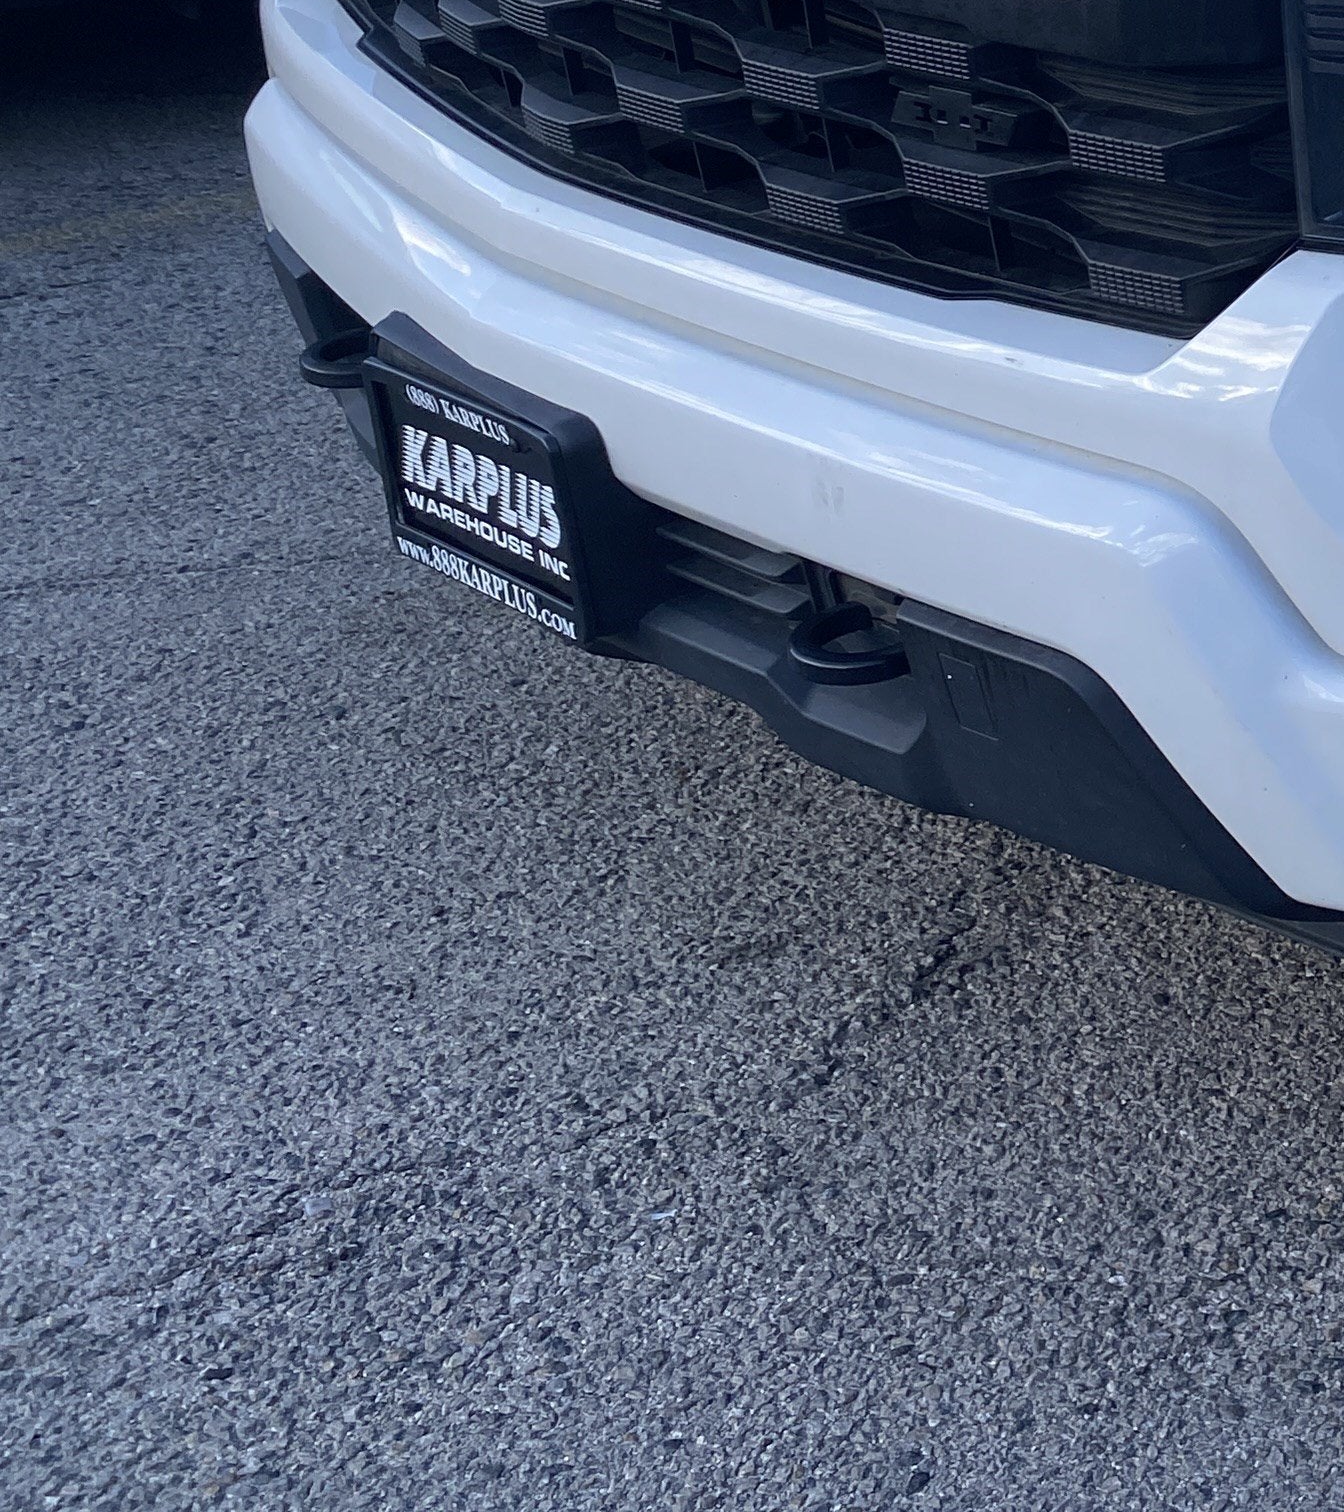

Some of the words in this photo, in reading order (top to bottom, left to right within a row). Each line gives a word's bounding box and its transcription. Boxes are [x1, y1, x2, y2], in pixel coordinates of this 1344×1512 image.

[405, 383, 440, 414] (888)
[440, 398, 510, 446] KARPLUS
[401, 424, 562, 550] KARPLUS
[405, 488, 534, 561] WAREHOUSE
[538, 548, 571, 581] INC
